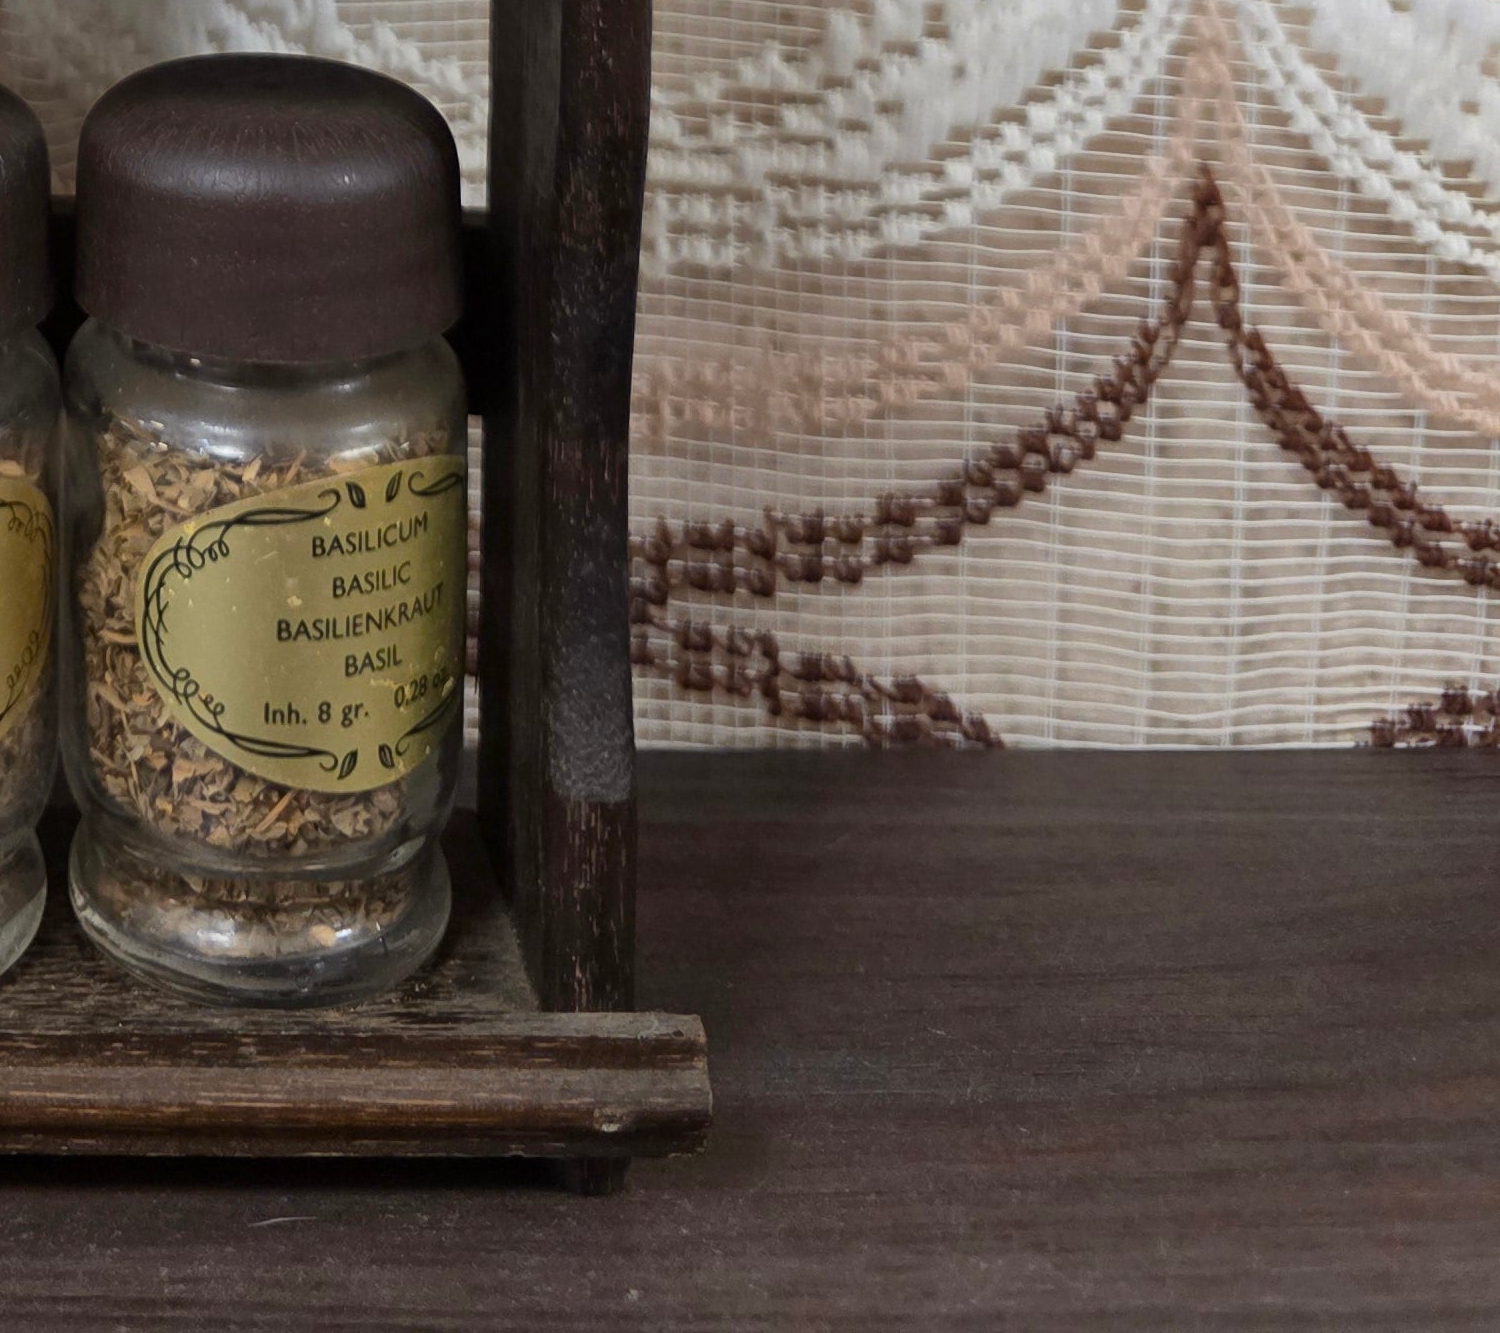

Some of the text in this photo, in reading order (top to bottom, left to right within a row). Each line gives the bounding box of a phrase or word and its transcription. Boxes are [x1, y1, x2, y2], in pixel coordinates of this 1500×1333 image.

[311, 512, 428, 559] BASILICUM
[332, 561, 412, 598] BASILIC
[276, 582, 444, 642] BASILIENKRAUT
[344, 645, 402, 677] BASIL
[264, 702, 307, 726] Inh.
[318, 702, 331, 723] 8
[341, 702, 369, 728] gr.
[394, 674, 430, 709] 0,28
